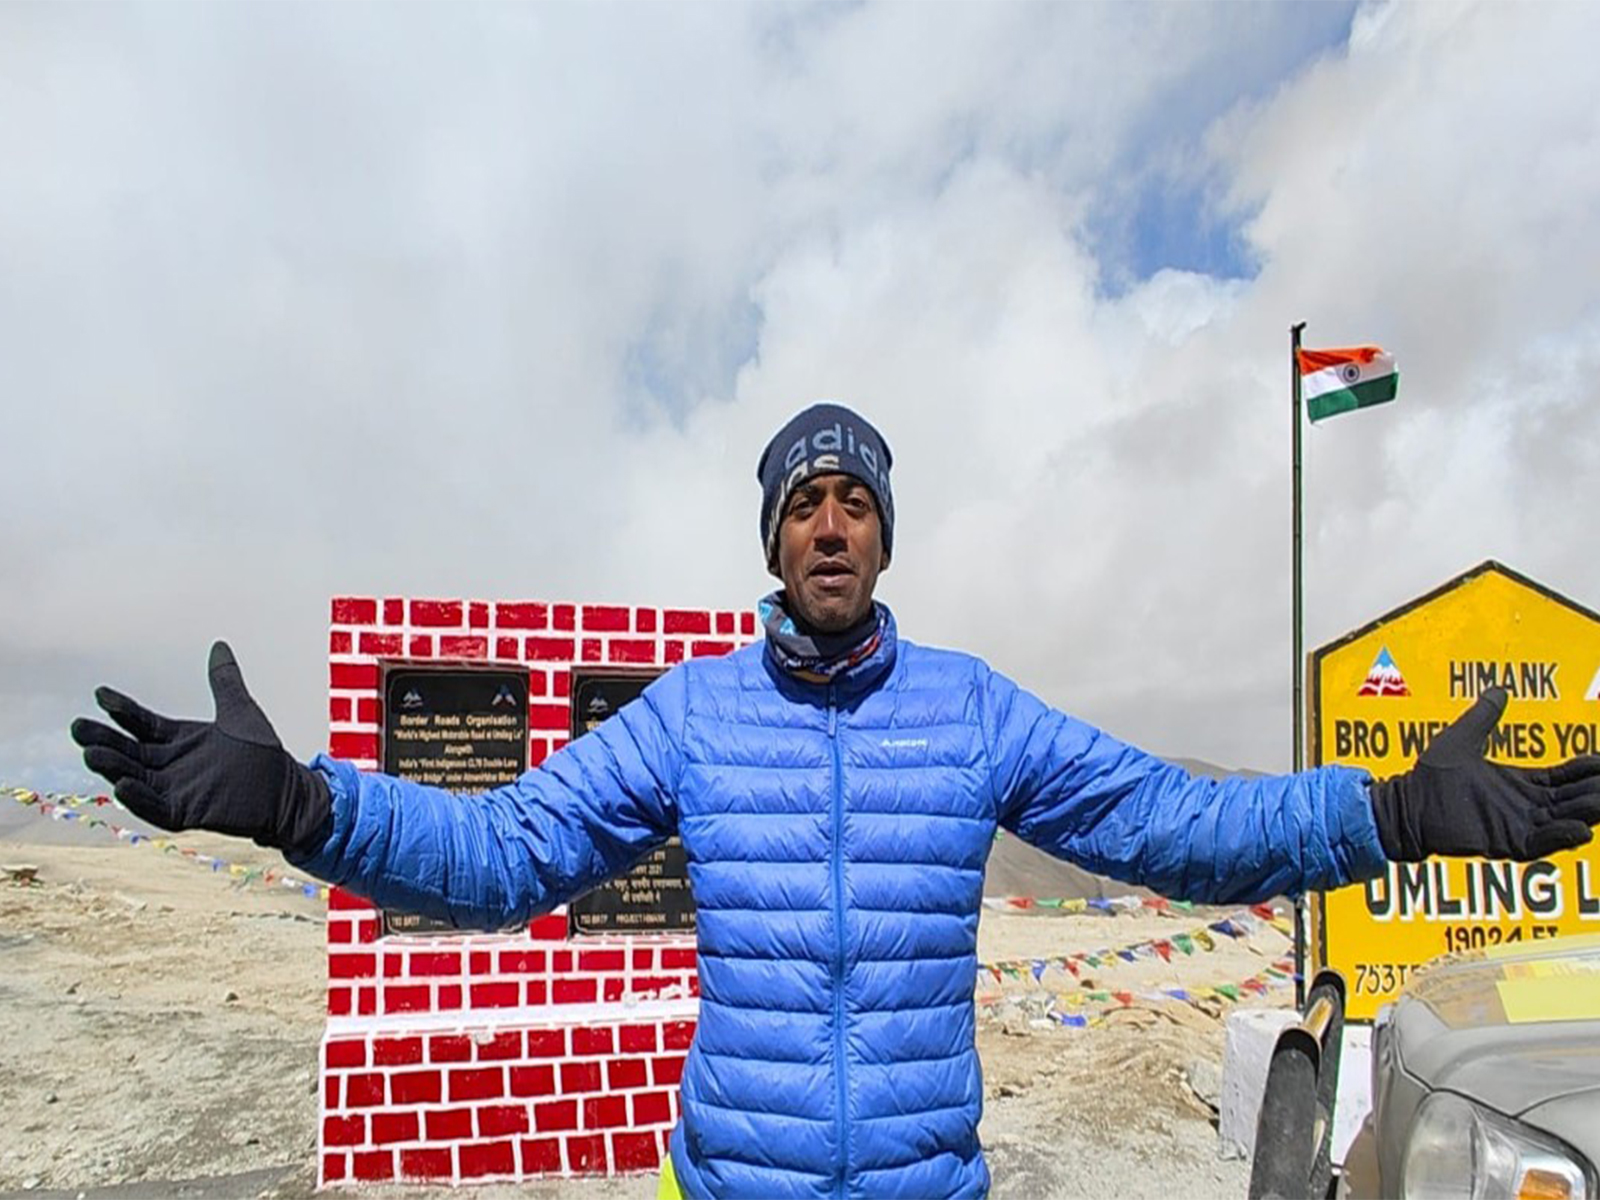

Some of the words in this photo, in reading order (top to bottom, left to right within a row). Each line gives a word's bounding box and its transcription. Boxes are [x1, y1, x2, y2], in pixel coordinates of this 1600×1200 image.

[785, 423, 892, 516] adida
[1449, 661, 1558, 699] HIMANK
[400, 715, 428, 726] Border
[435, 715, 460, 726] Roads
[466, 715, 517, 728] Organisation
[1335, 720, 1389, 757] BRO
[1398, 721, 1546, 758] WEMES
[1365, 860, 1563, 921] UMLING
